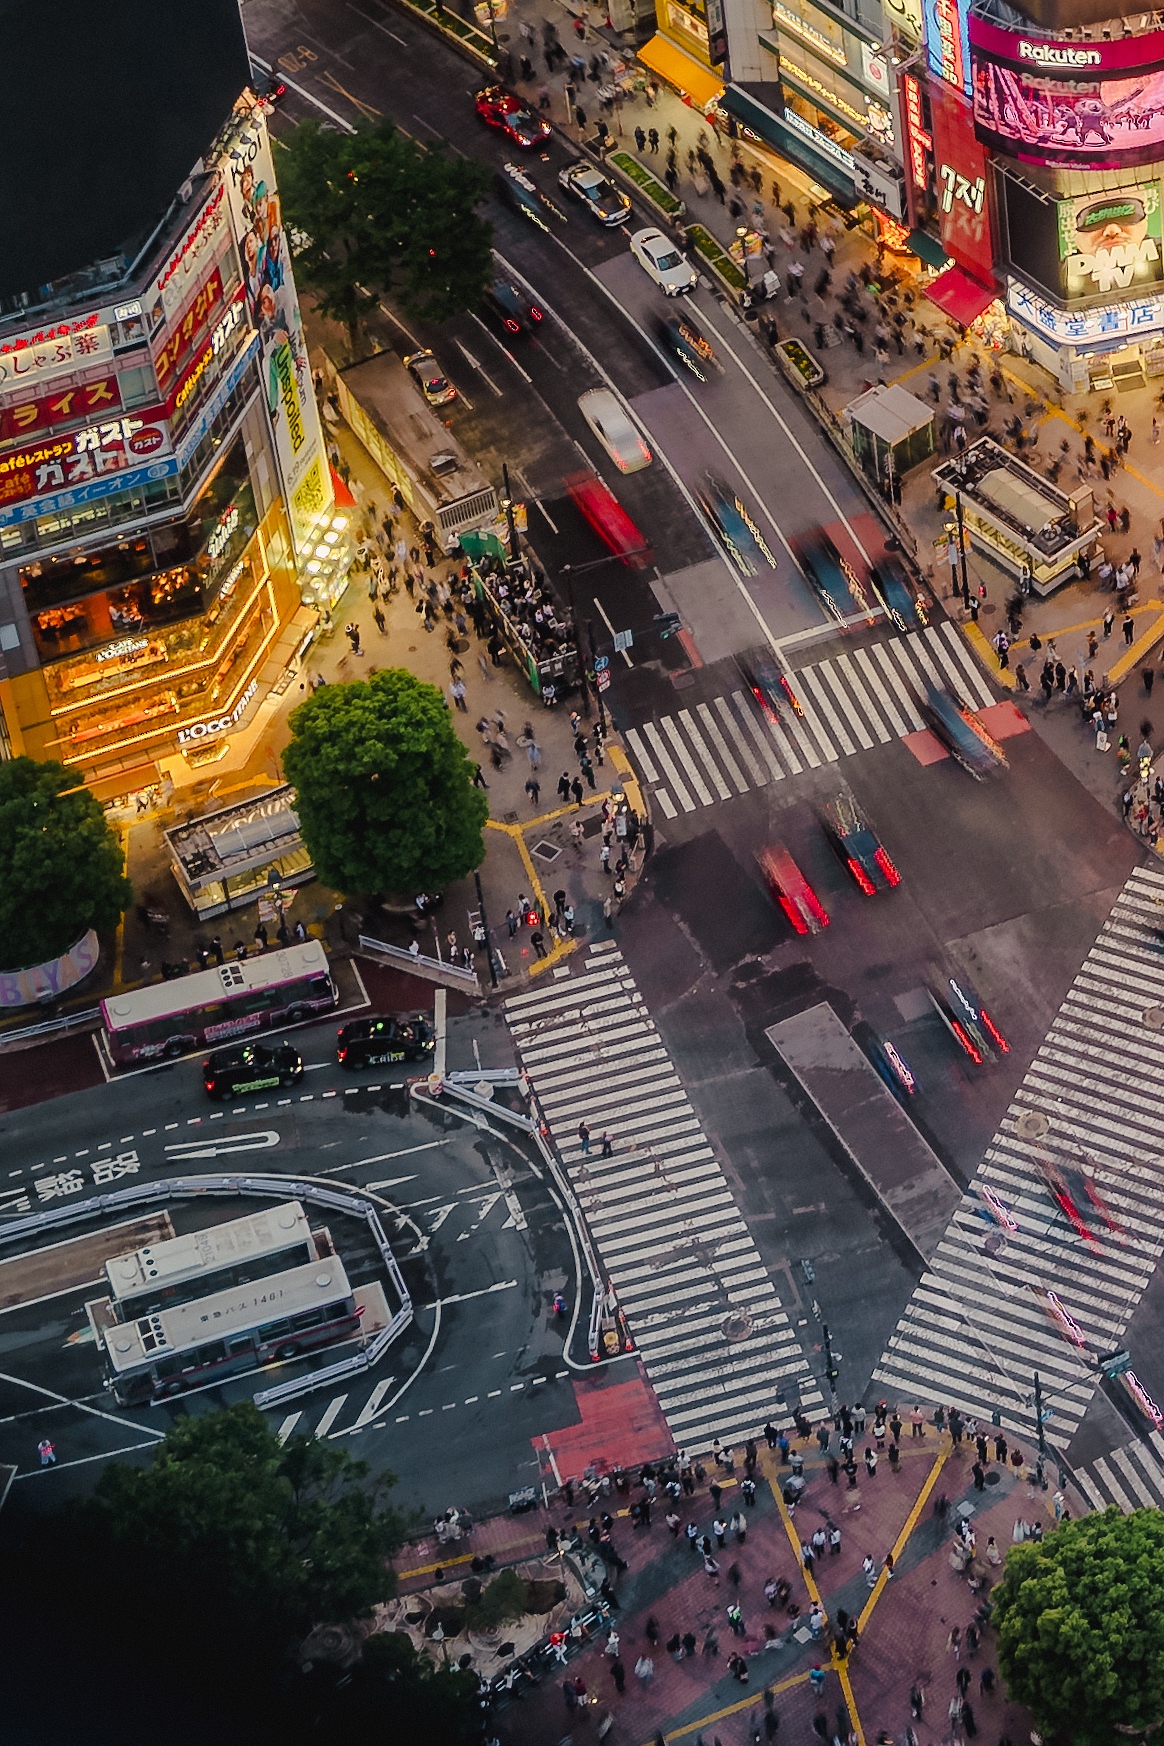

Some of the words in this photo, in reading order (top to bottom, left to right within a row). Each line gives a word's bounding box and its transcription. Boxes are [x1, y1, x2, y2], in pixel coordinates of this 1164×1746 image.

[1019, 41, 1101, 65] Rakuten
[1067, 239, 1160, 276] DMM
[1091, 264, 1135, 293] TV
[155, 280, 219, 386] コンタクト
[213, 300, 244, 355] ガスト
[14, 333, 100, 375] しゃぶ葉
[274, 342, 304, 453] Unspoiled
[76, 418, 144, 453] ガスト
[134, 435, 161, 450] ガスト
[178, 678, 259, 744] L'OCCITANE
